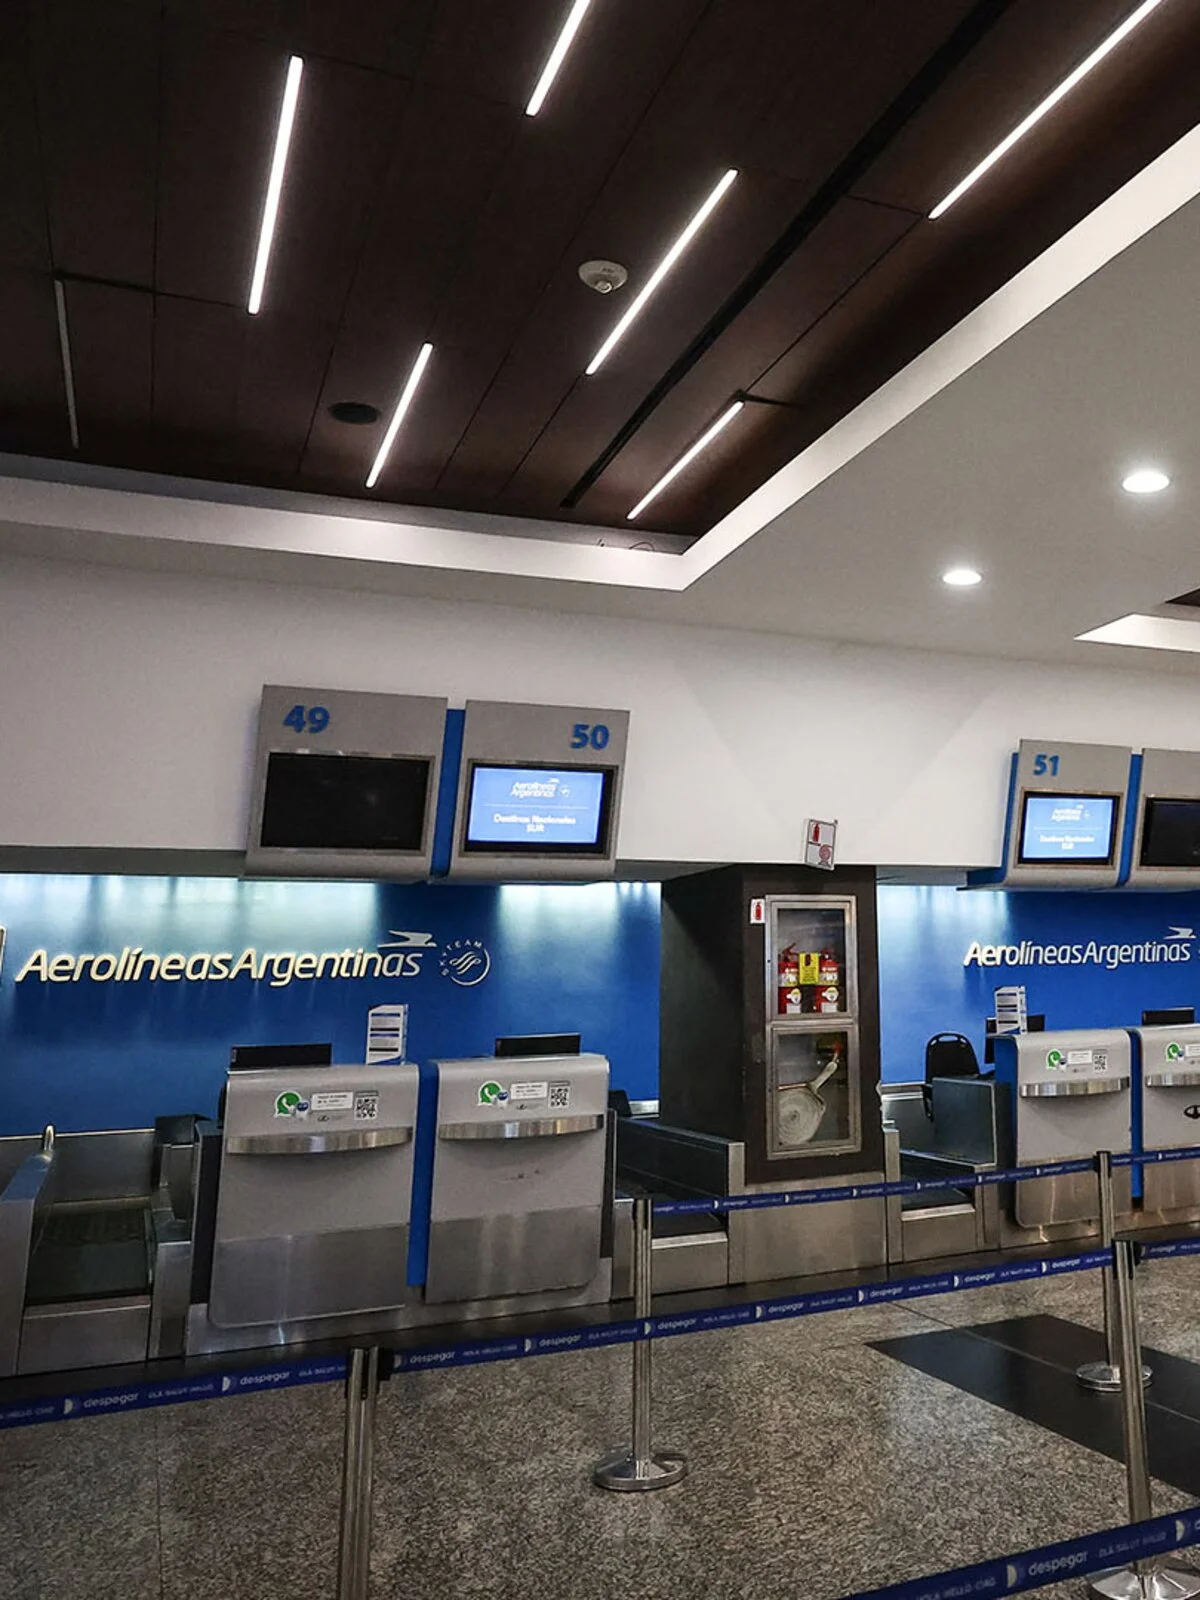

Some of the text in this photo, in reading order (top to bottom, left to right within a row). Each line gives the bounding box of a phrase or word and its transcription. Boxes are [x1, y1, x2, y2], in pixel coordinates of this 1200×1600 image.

[282, 705, 330, 733] 49
[570, 724, 610, 750] 50
[1033, 754, 1060, 776] 51
[410, 1351, 456, 1363] despegar
[240, 1371, 290, 1385] despegar
[83, 1393, 139, 1408] despegar
[1028, 1551, 1088, 1576] despegar
